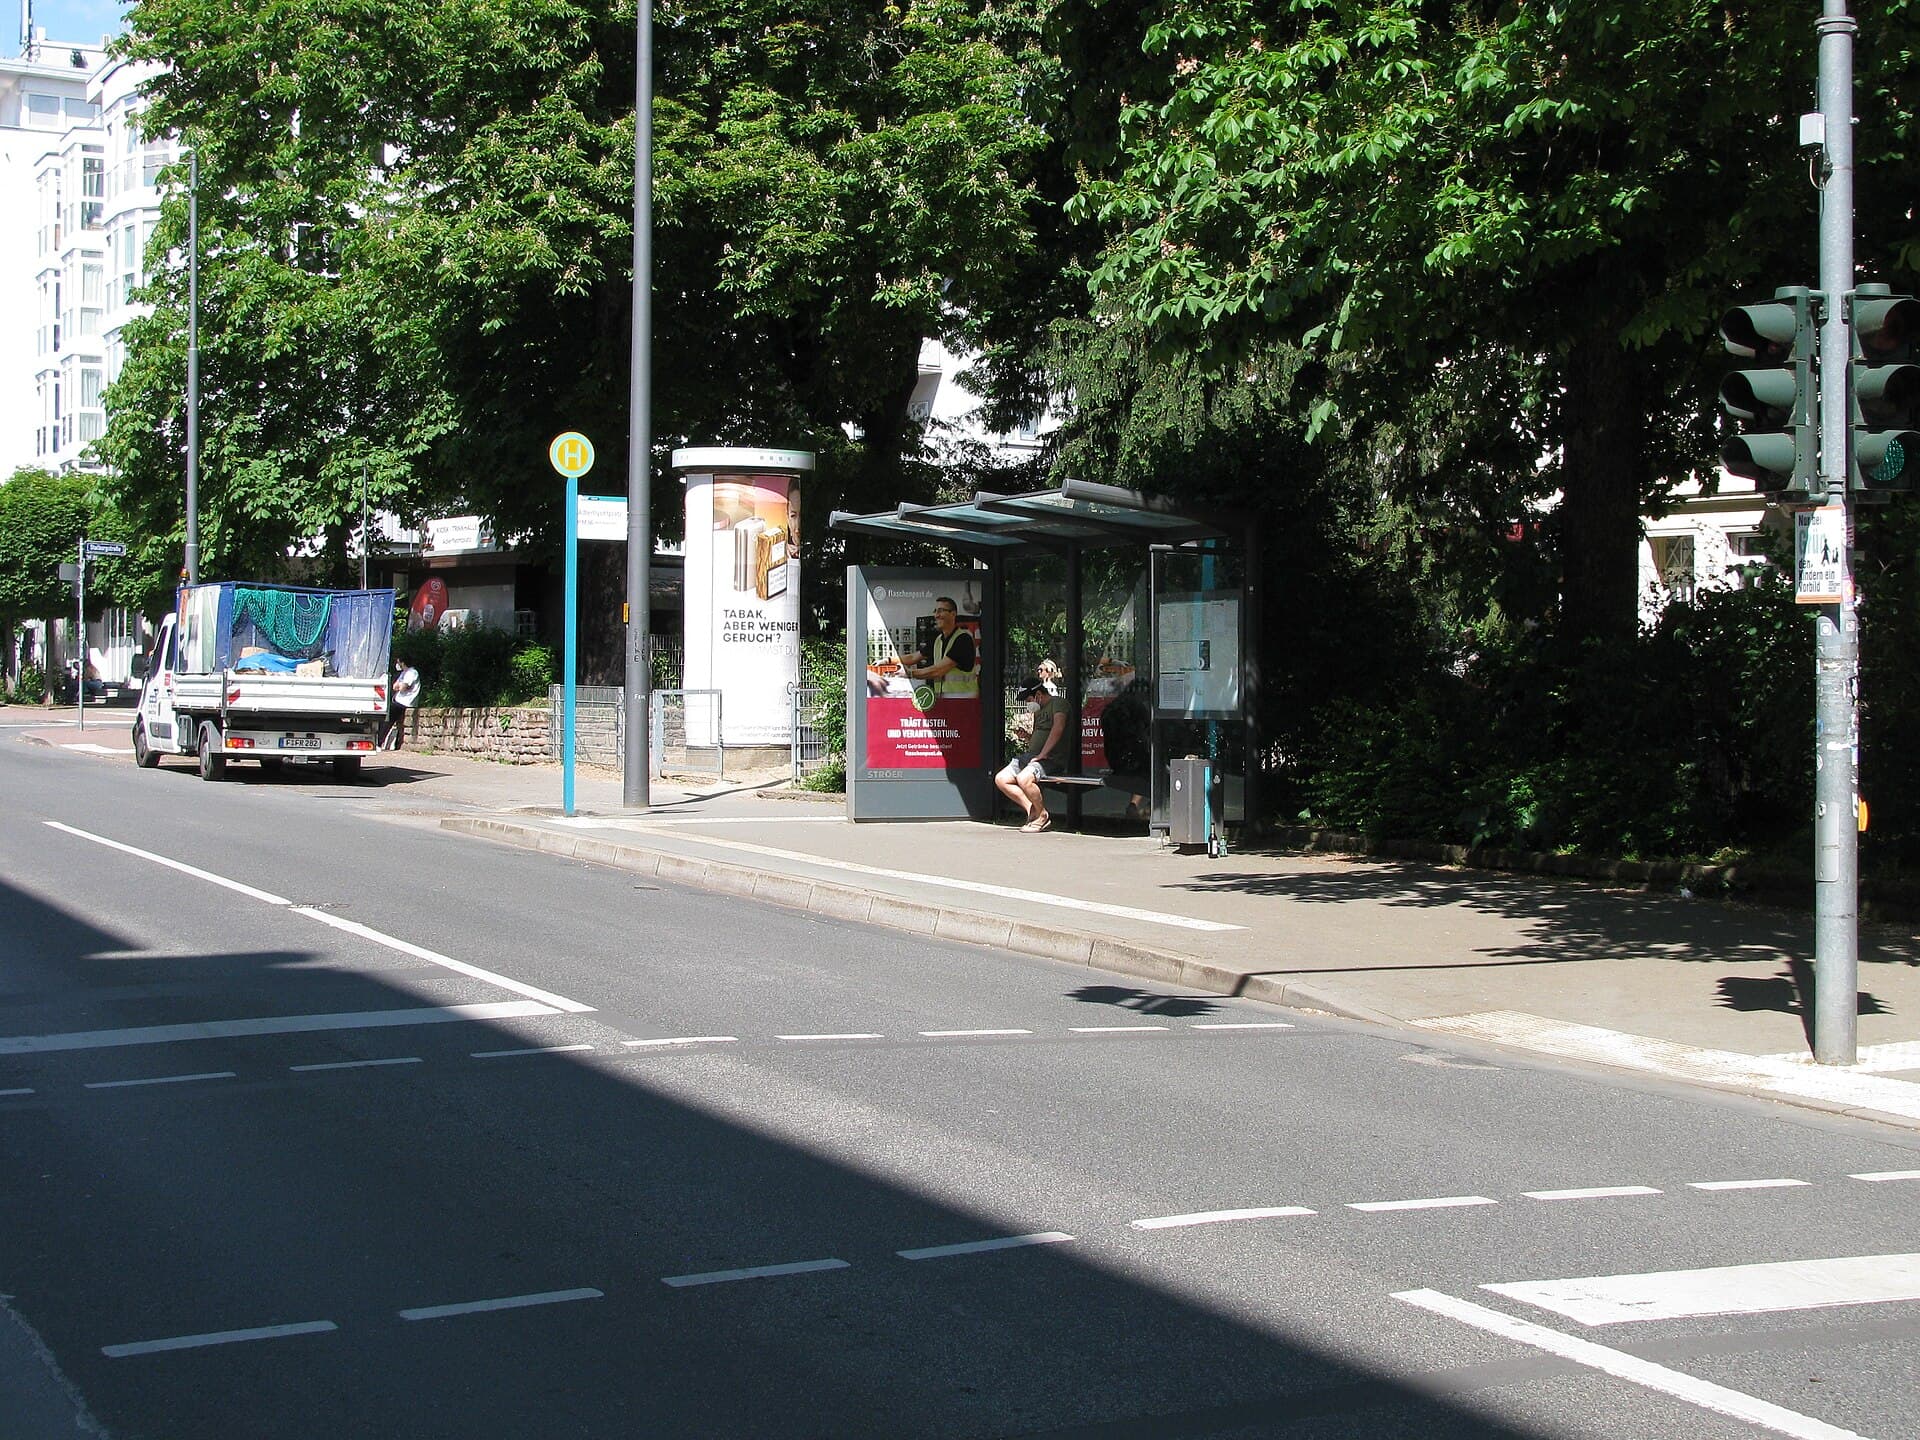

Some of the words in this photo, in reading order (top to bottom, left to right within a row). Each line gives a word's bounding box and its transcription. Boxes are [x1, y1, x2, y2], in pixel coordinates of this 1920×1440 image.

[564, 443, 581, 468] H
[723, 609, 767, 620] TABAK,
[723, 621, 755, 631] ABER
[900, 716, 921, 728] TRÄGT
[922, 719, 948, 728] KISTEN.
[887, 729, 901, 738] UND
[902, 729, 960, 738] VERANTWORTUNG.
[867, 770, 904, 779] STRÖER
